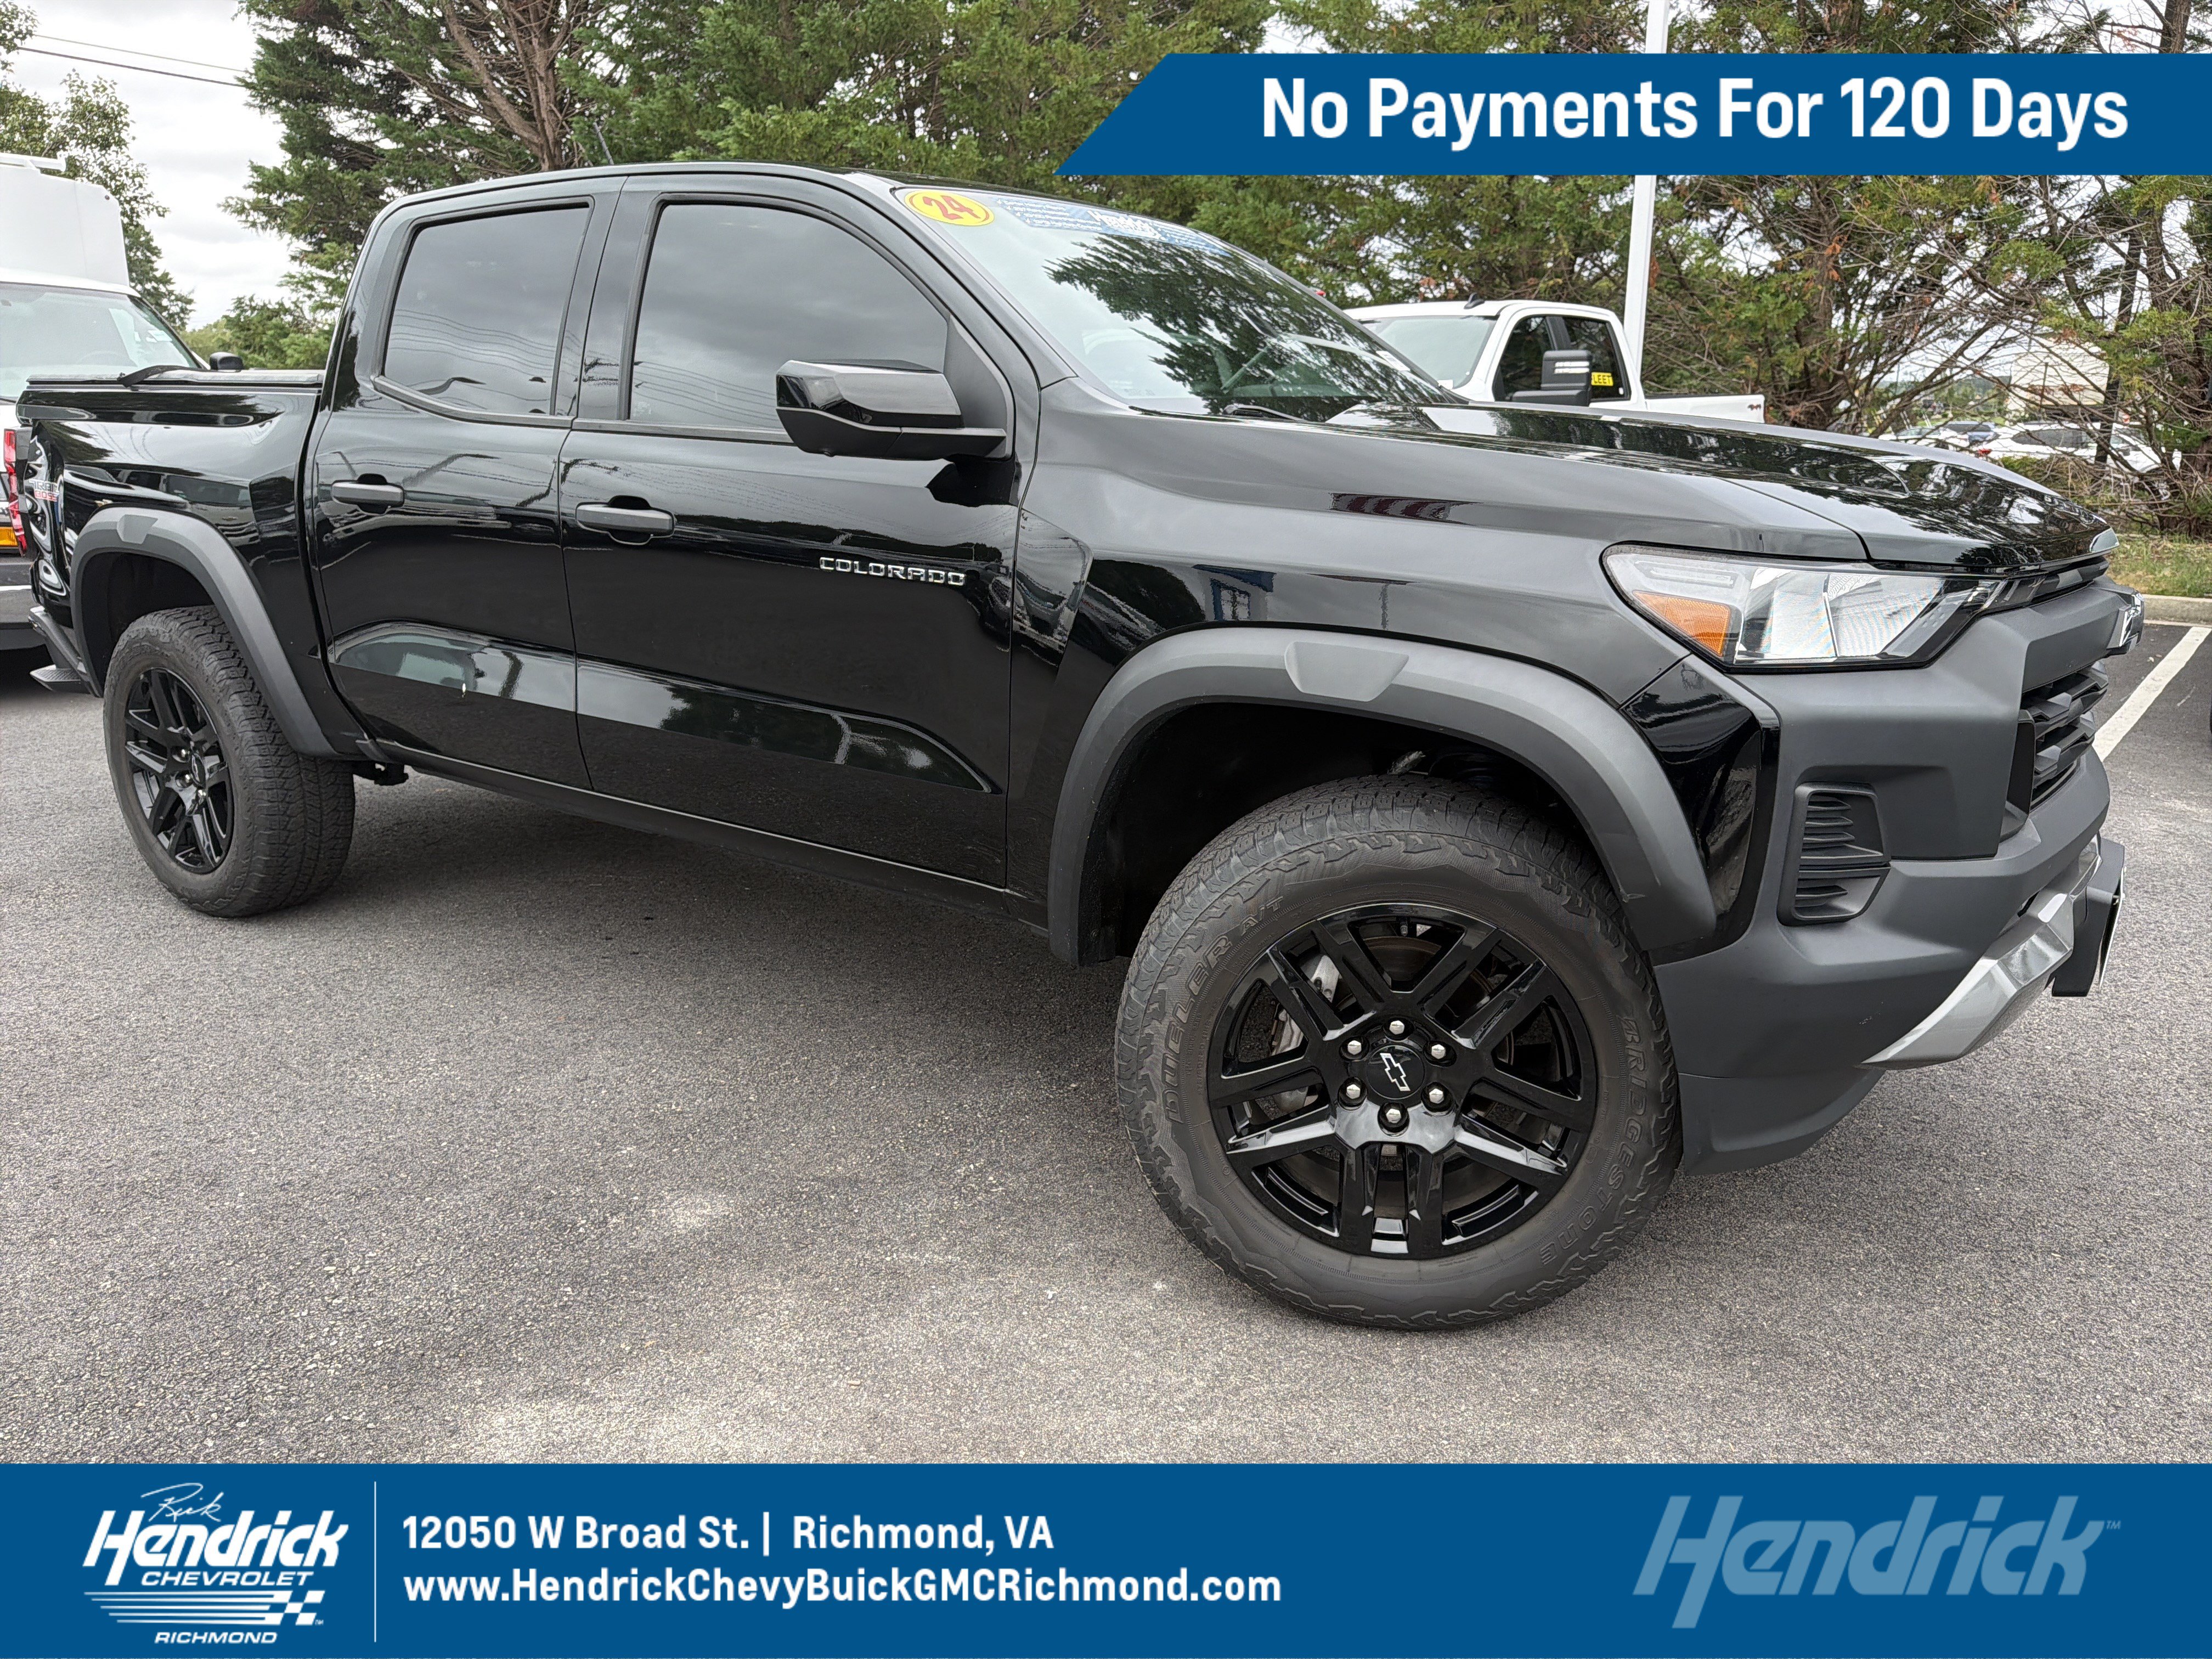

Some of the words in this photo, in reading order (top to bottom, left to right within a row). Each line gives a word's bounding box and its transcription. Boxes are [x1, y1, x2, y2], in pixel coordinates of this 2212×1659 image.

[923, 195, 981, 220] 24
[1593, 374, 1612, 384] LEET
[819, 556, 967, 586] COLORADO
[1162, 934, 1233, 1125] DUELER
[1539, 1014, 1647, 1266] BRIDGESTONE
